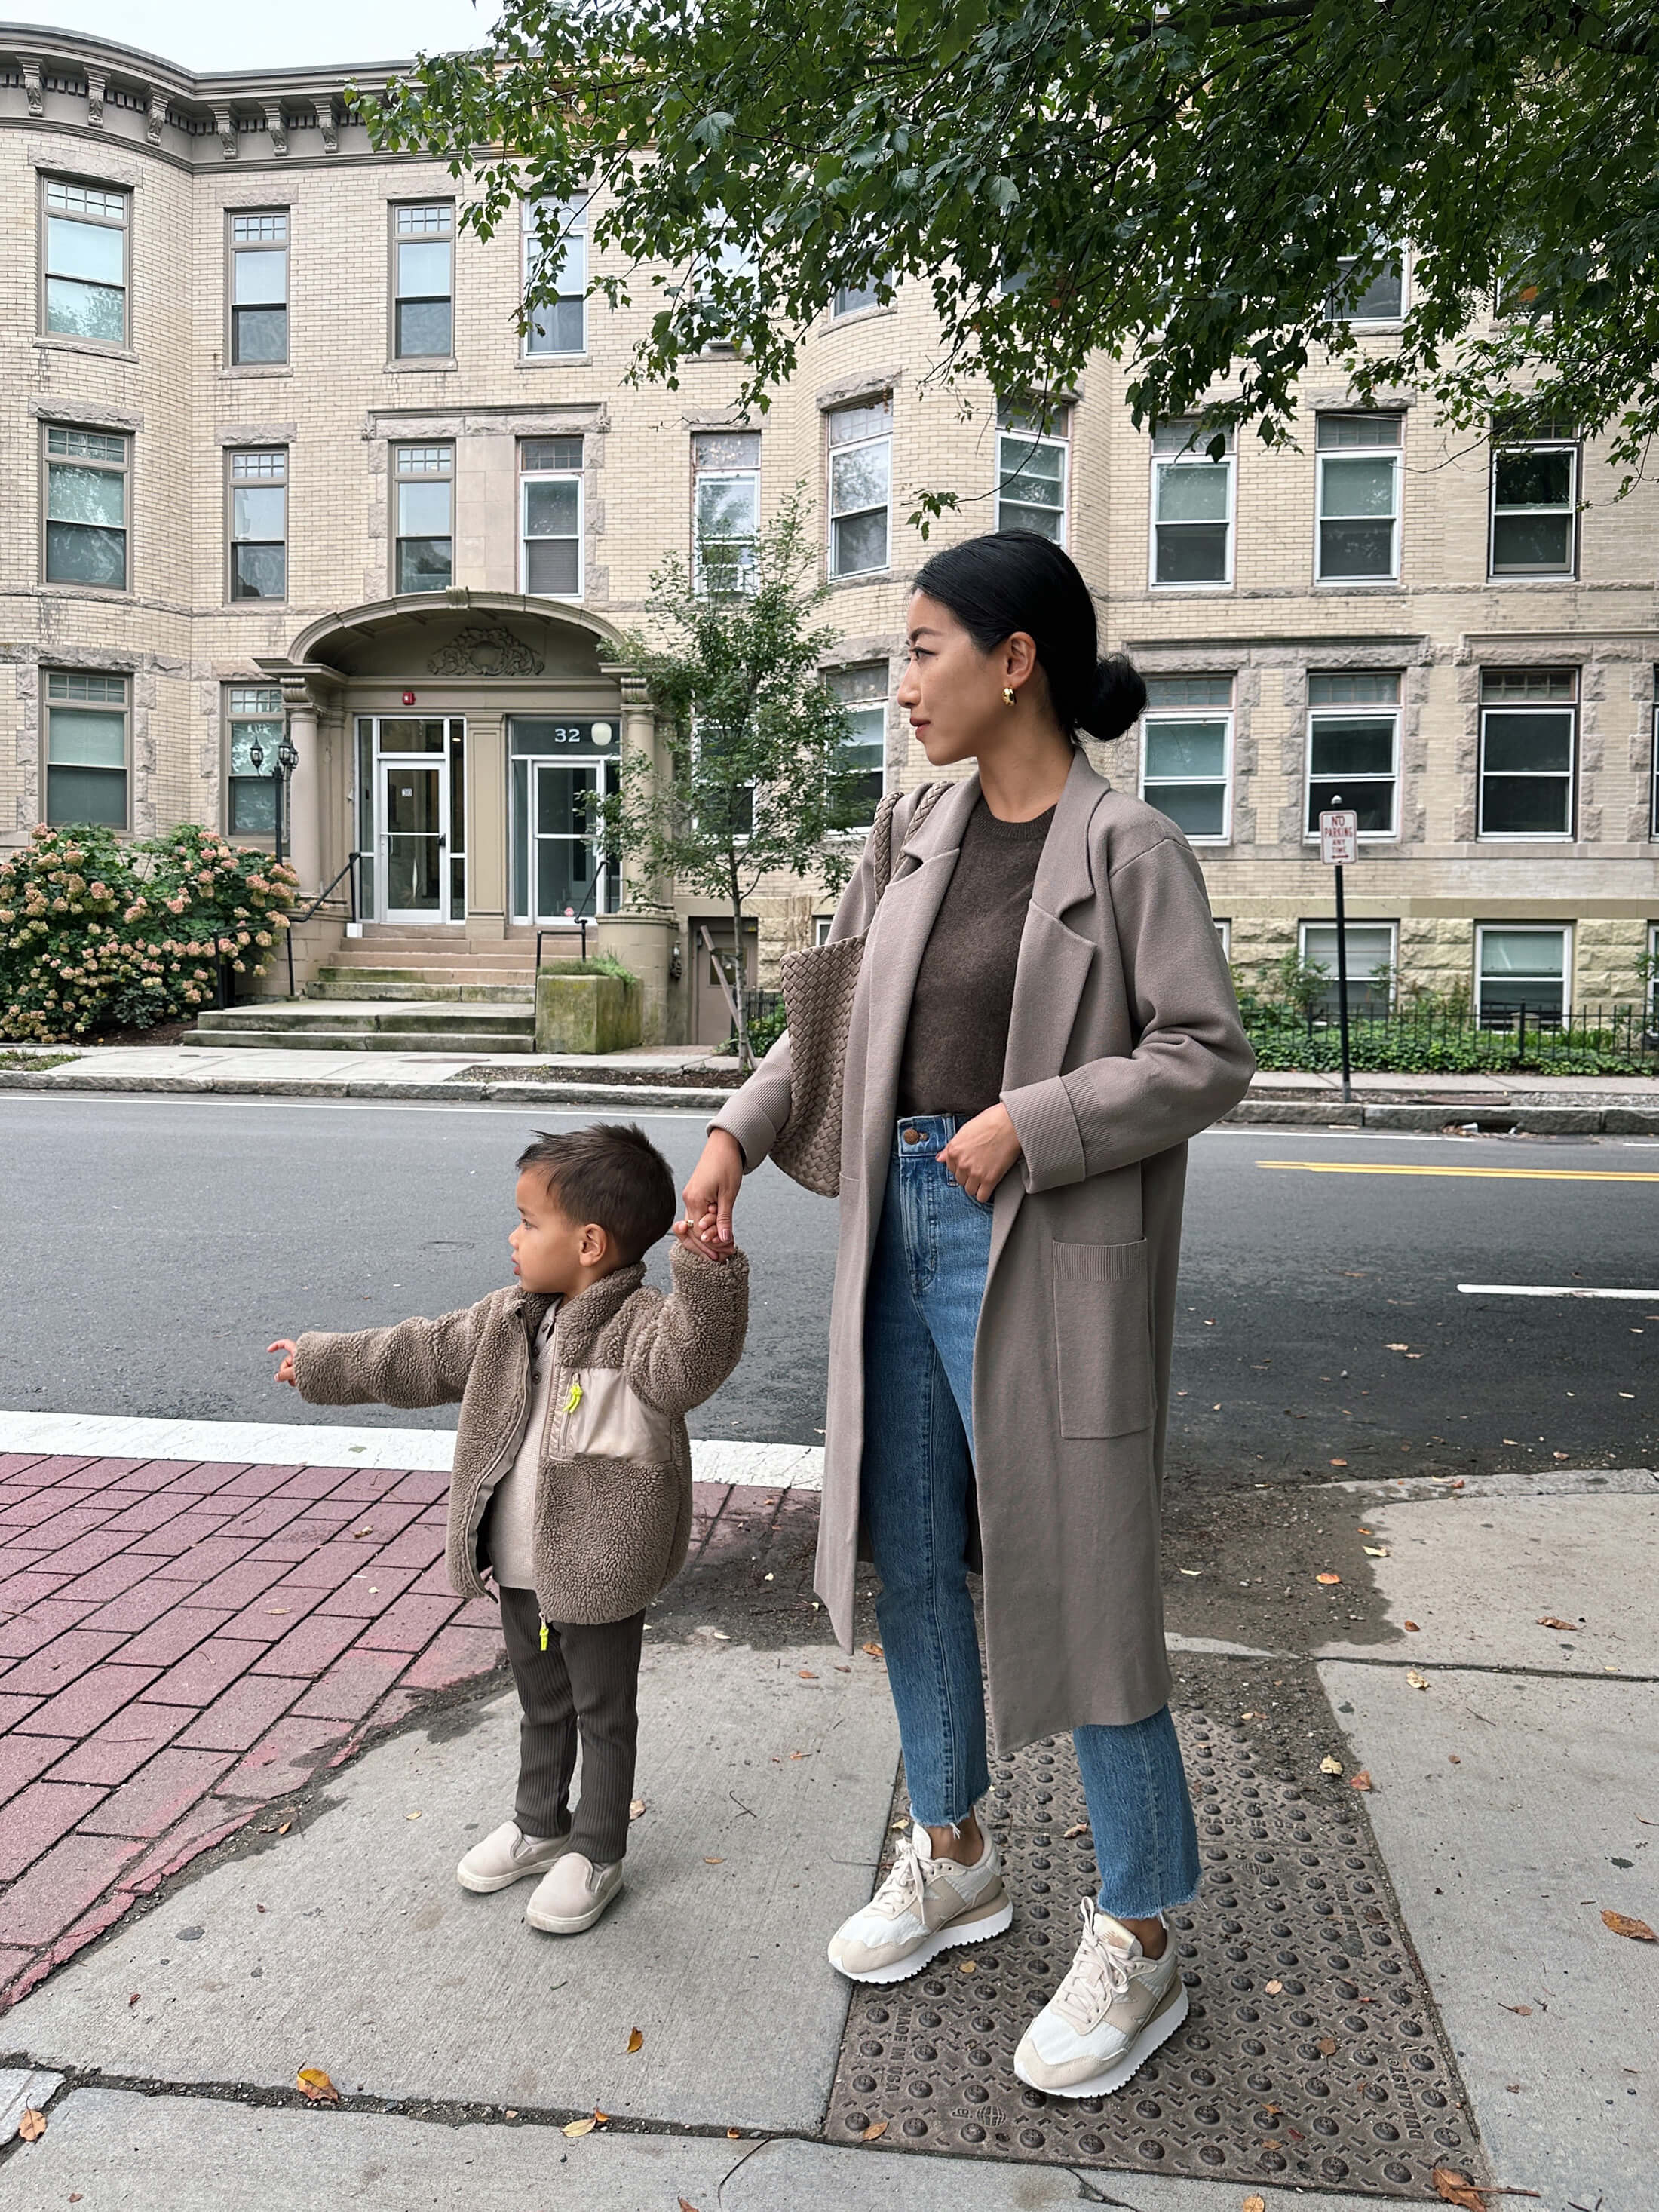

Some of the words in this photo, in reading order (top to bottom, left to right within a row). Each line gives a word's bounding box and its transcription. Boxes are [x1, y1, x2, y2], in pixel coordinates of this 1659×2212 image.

[554, 728, 580, 742] 32
[1332, 815, 1345, 827] NO
[1324, 827, 1353, 838] PARKING
[893, 2007, 912, 2042] MADE
[890, 2046, 906, 2060] IN
[885, 2066, 903, 2092] USA
